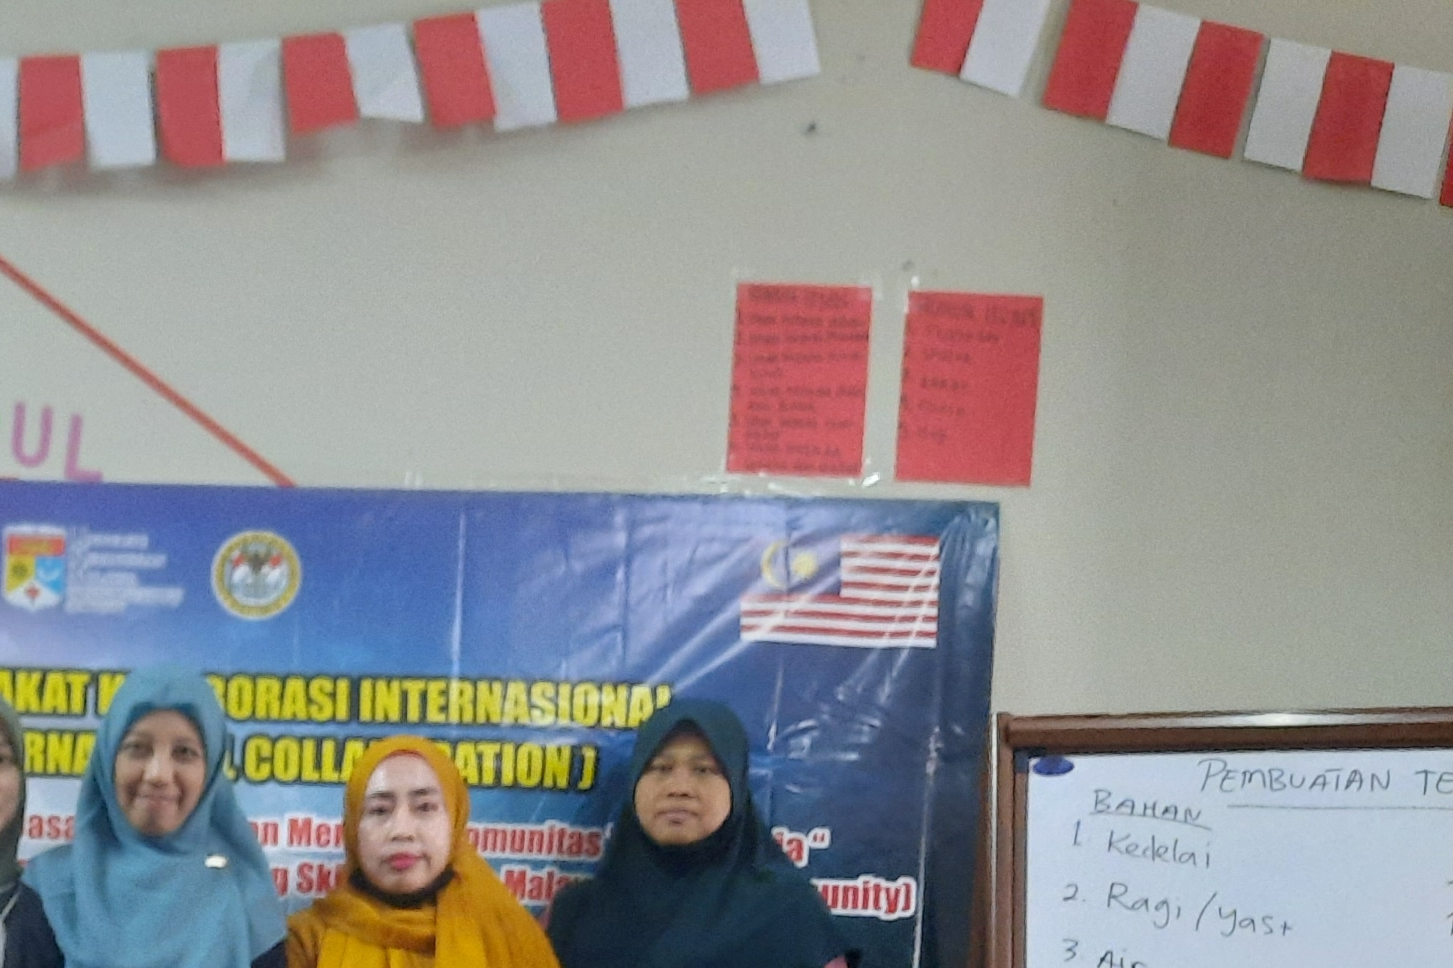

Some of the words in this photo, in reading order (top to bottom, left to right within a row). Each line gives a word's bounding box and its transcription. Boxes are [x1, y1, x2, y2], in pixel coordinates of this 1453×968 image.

[1198, 758, 1392, 795] PEMBUATAN
[1414, 770, 1453, 795] TE
[1093, 788, 1203, 823] BAHAN
[1107, 829, 1212, 869] Kedelai
